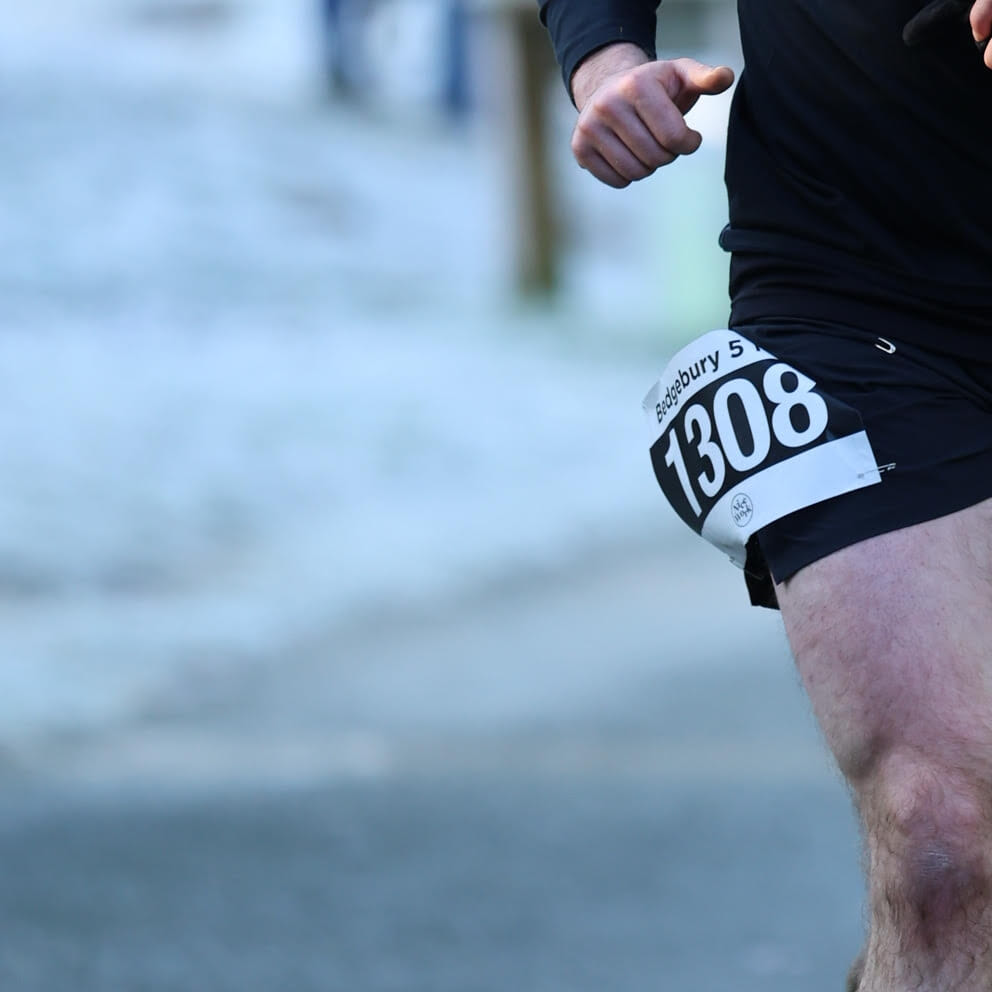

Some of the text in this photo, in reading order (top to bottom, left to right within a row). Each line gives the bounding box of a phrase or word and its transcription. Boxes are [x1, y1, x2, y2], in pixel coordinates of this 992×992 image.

[655, 339, 744, 424] Bedgebury 5
[664, 363, 829, 518] 1308
